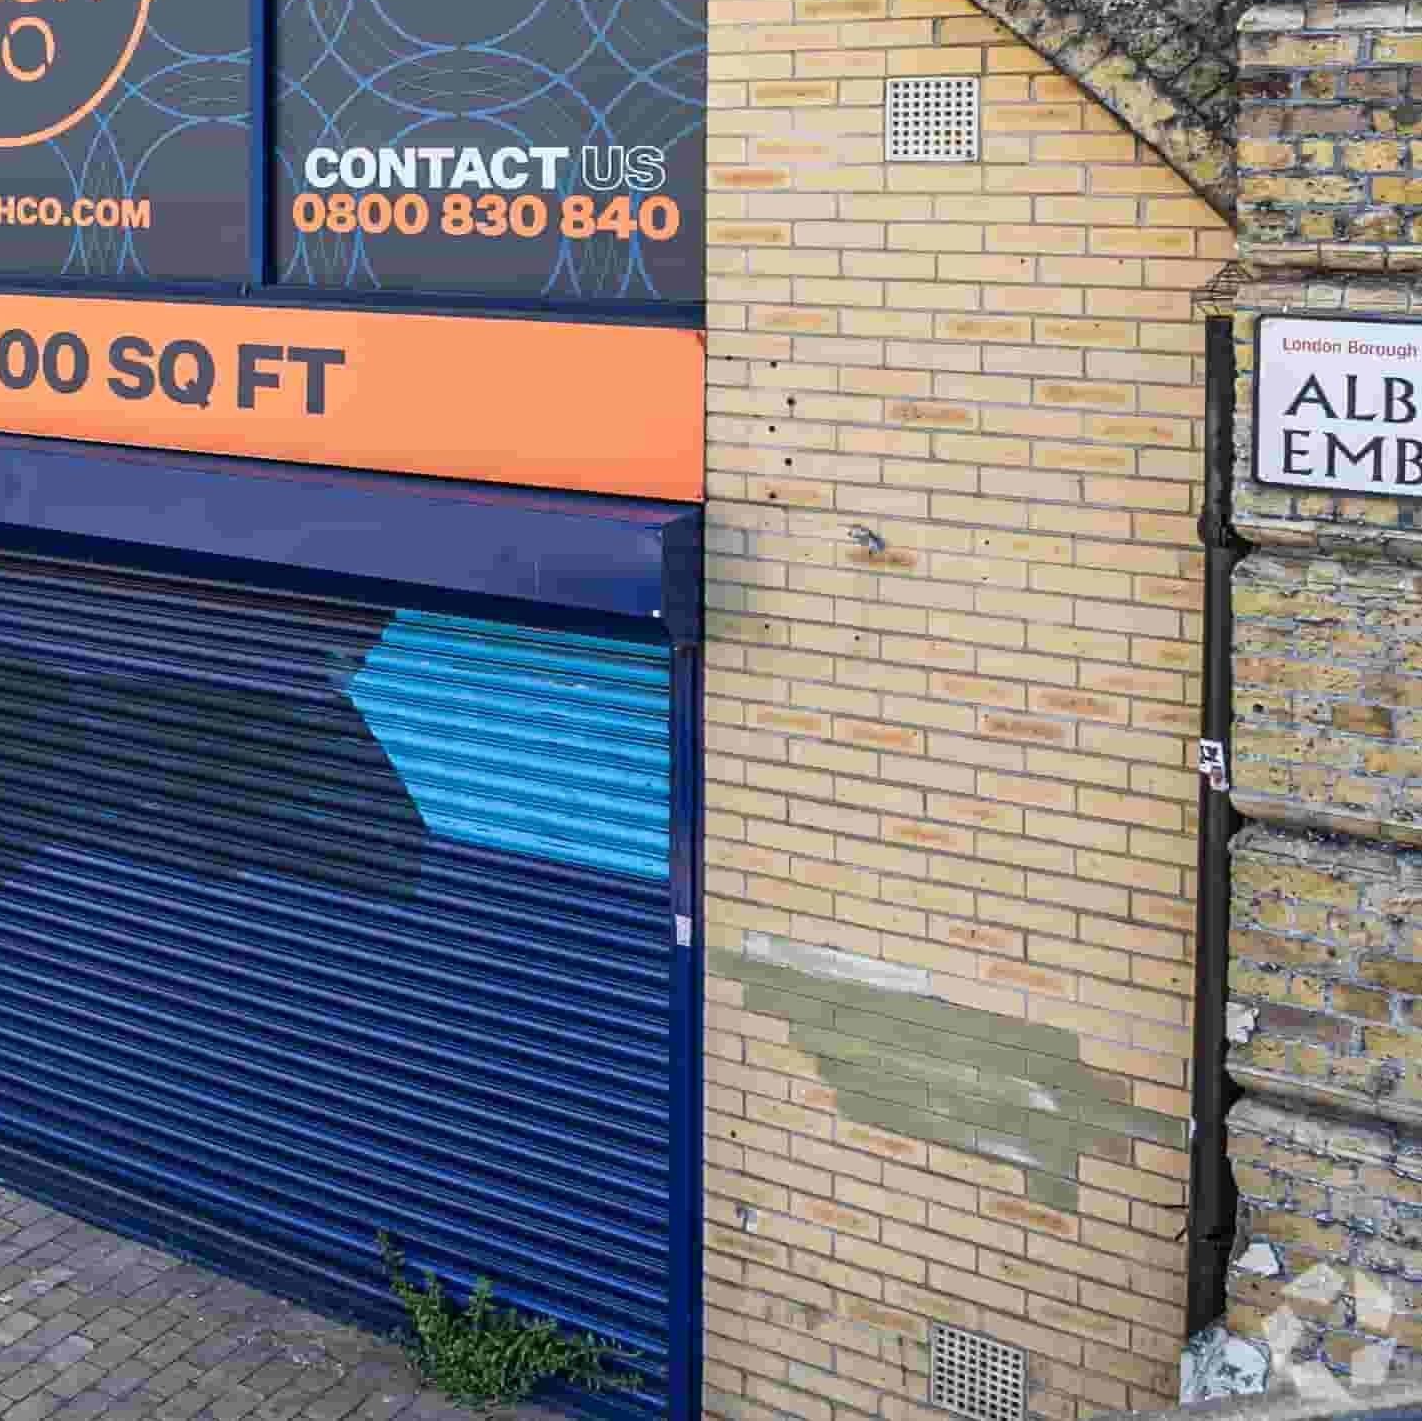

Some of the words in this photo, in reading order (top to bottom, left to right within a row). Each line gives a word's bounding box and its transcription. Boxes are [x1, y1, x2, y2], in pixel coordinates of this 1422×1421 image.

[304, 146, 568, 190] CONTACT
[581, 146, 665, 191] US
[292, 193, 429, 235] 0800
[441, 194, 547, 237] 830
[559, 195, 679, 241] 840
[1283, 338, 1341, 354] London
[1348, 340, 1417, 361] Borough
[107, 338, 215, 409] SQ
[237, 343, 347, 414] FT
[1283, 373, 1417, 424] ALB
[1283, 428, 1422, 485] EMB
